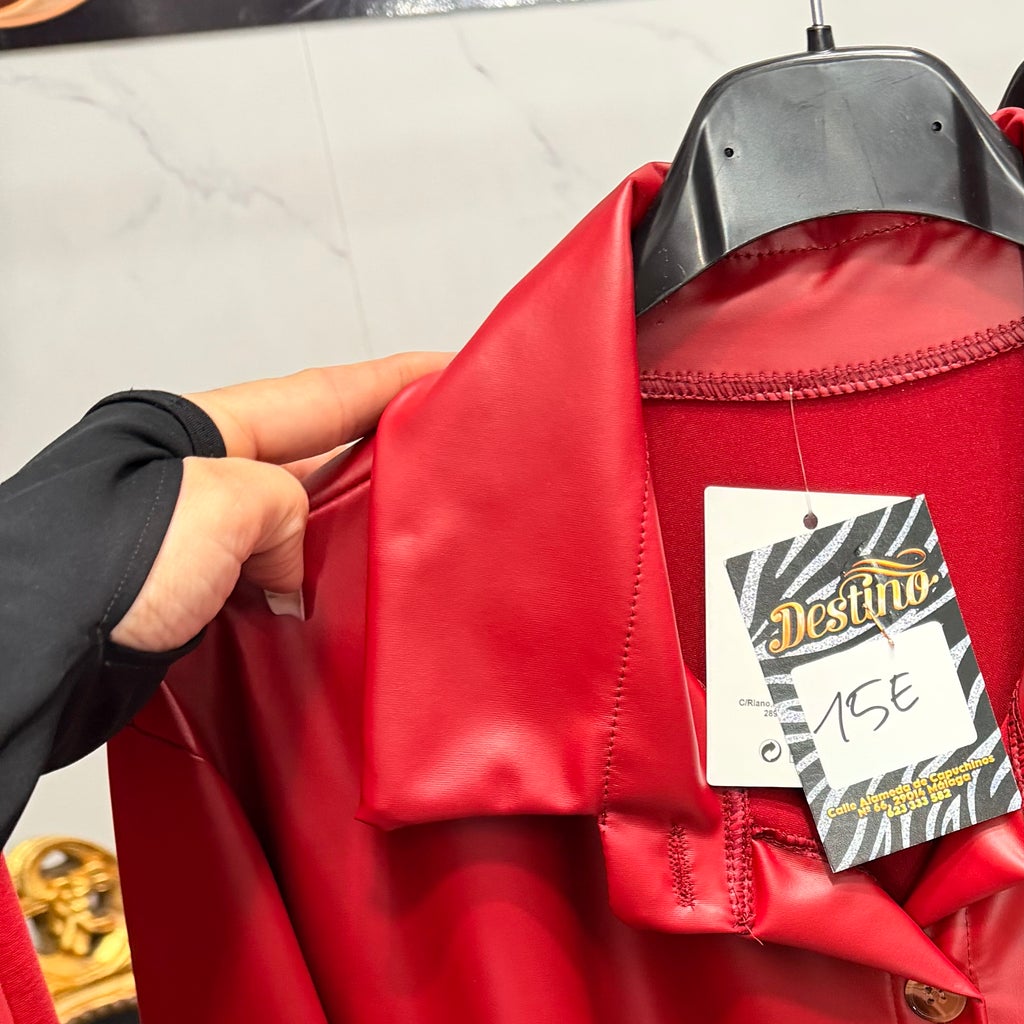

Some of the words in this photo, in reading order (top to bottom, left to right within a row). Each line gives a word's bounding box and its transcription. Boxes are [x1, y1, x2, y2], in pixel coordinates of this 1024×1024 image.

[769, 558, 939, 653] Destino
[827, 802, 857, 818] Calle
[860, 784, 913, 808] Alameda
[912, 777, 927, 789] de
[929, 754, 996, 783] Capuchinos
[887, 803, 908, 818] 623
[908, 796, 929, 811] 333
[930, 788, 953, 803] 582
[892, 787, 926, 806] 29014
[926, 773, 972, 795] Málaga
